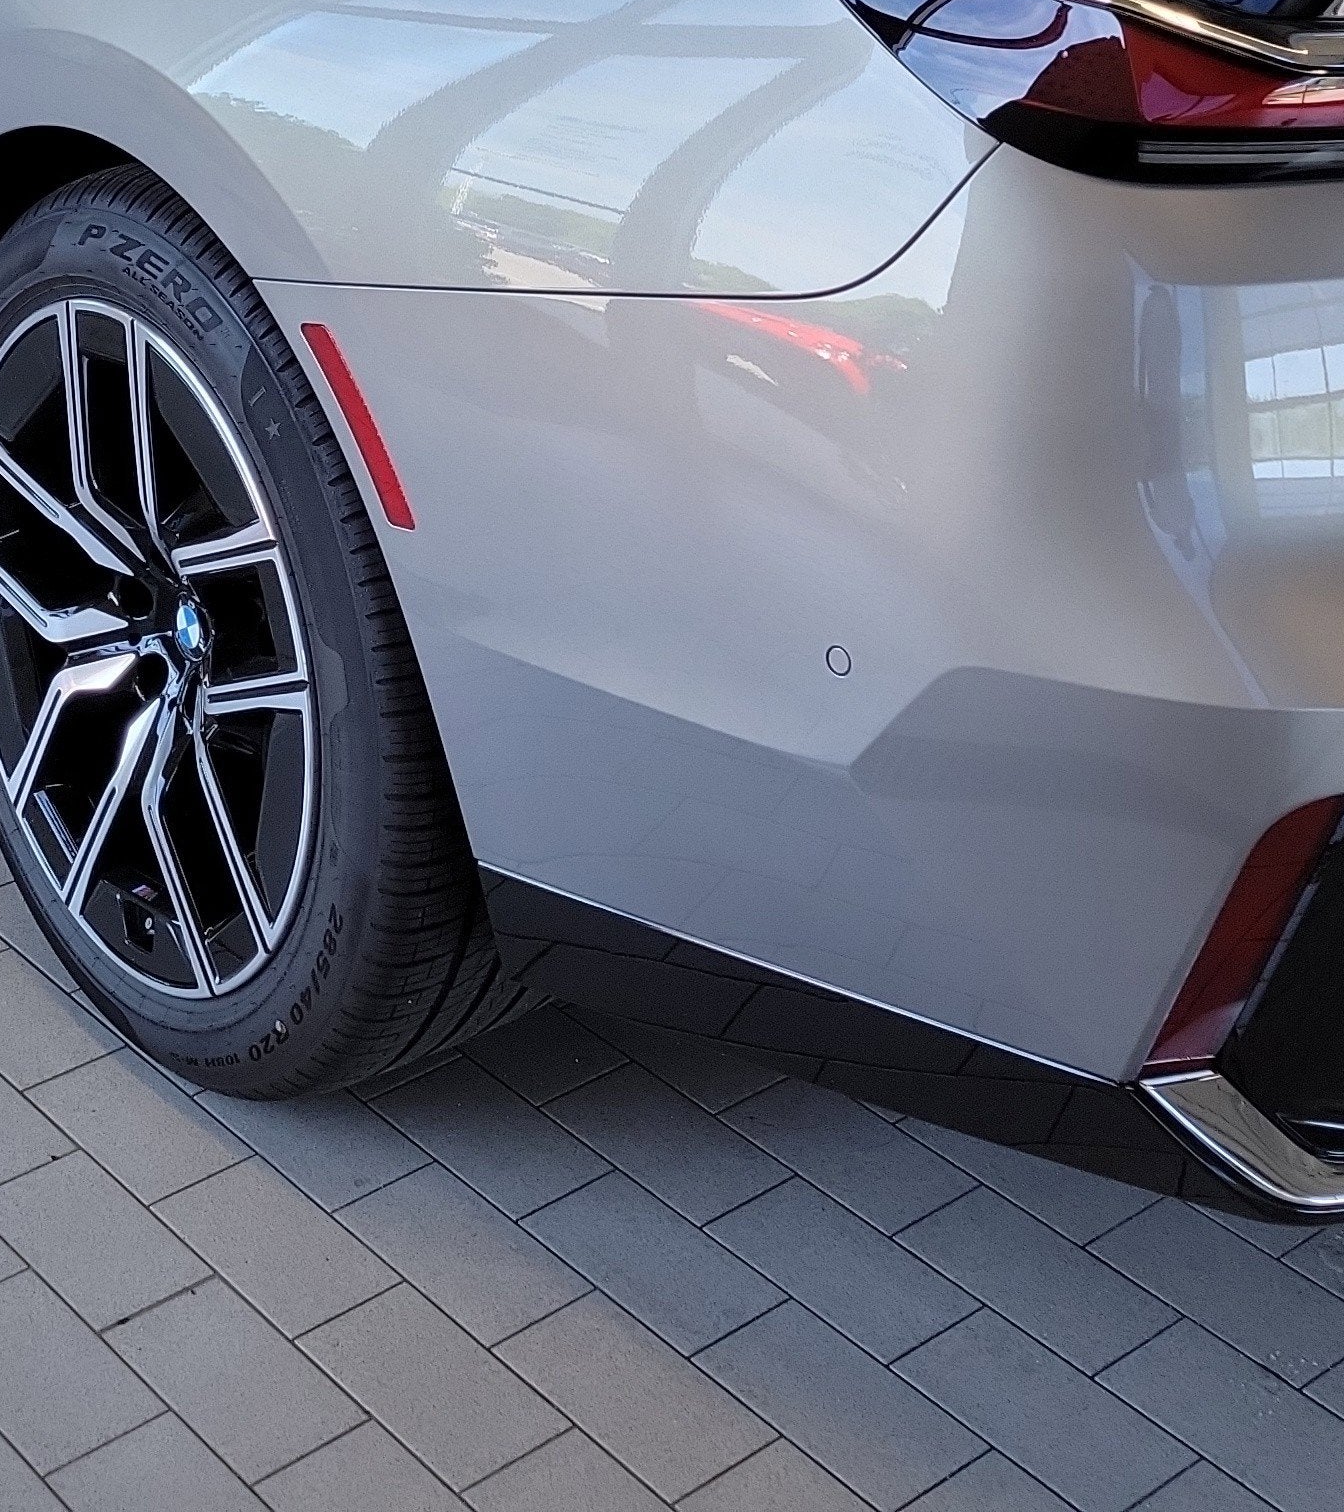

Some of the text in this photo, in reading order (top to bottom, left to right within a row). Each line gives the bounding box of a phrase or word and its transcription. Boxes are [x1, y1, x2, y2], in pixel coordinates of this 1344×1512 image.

[78, 223, 223, 332] P ZERO
[122, 266, 205, 341] ALL SEASON
